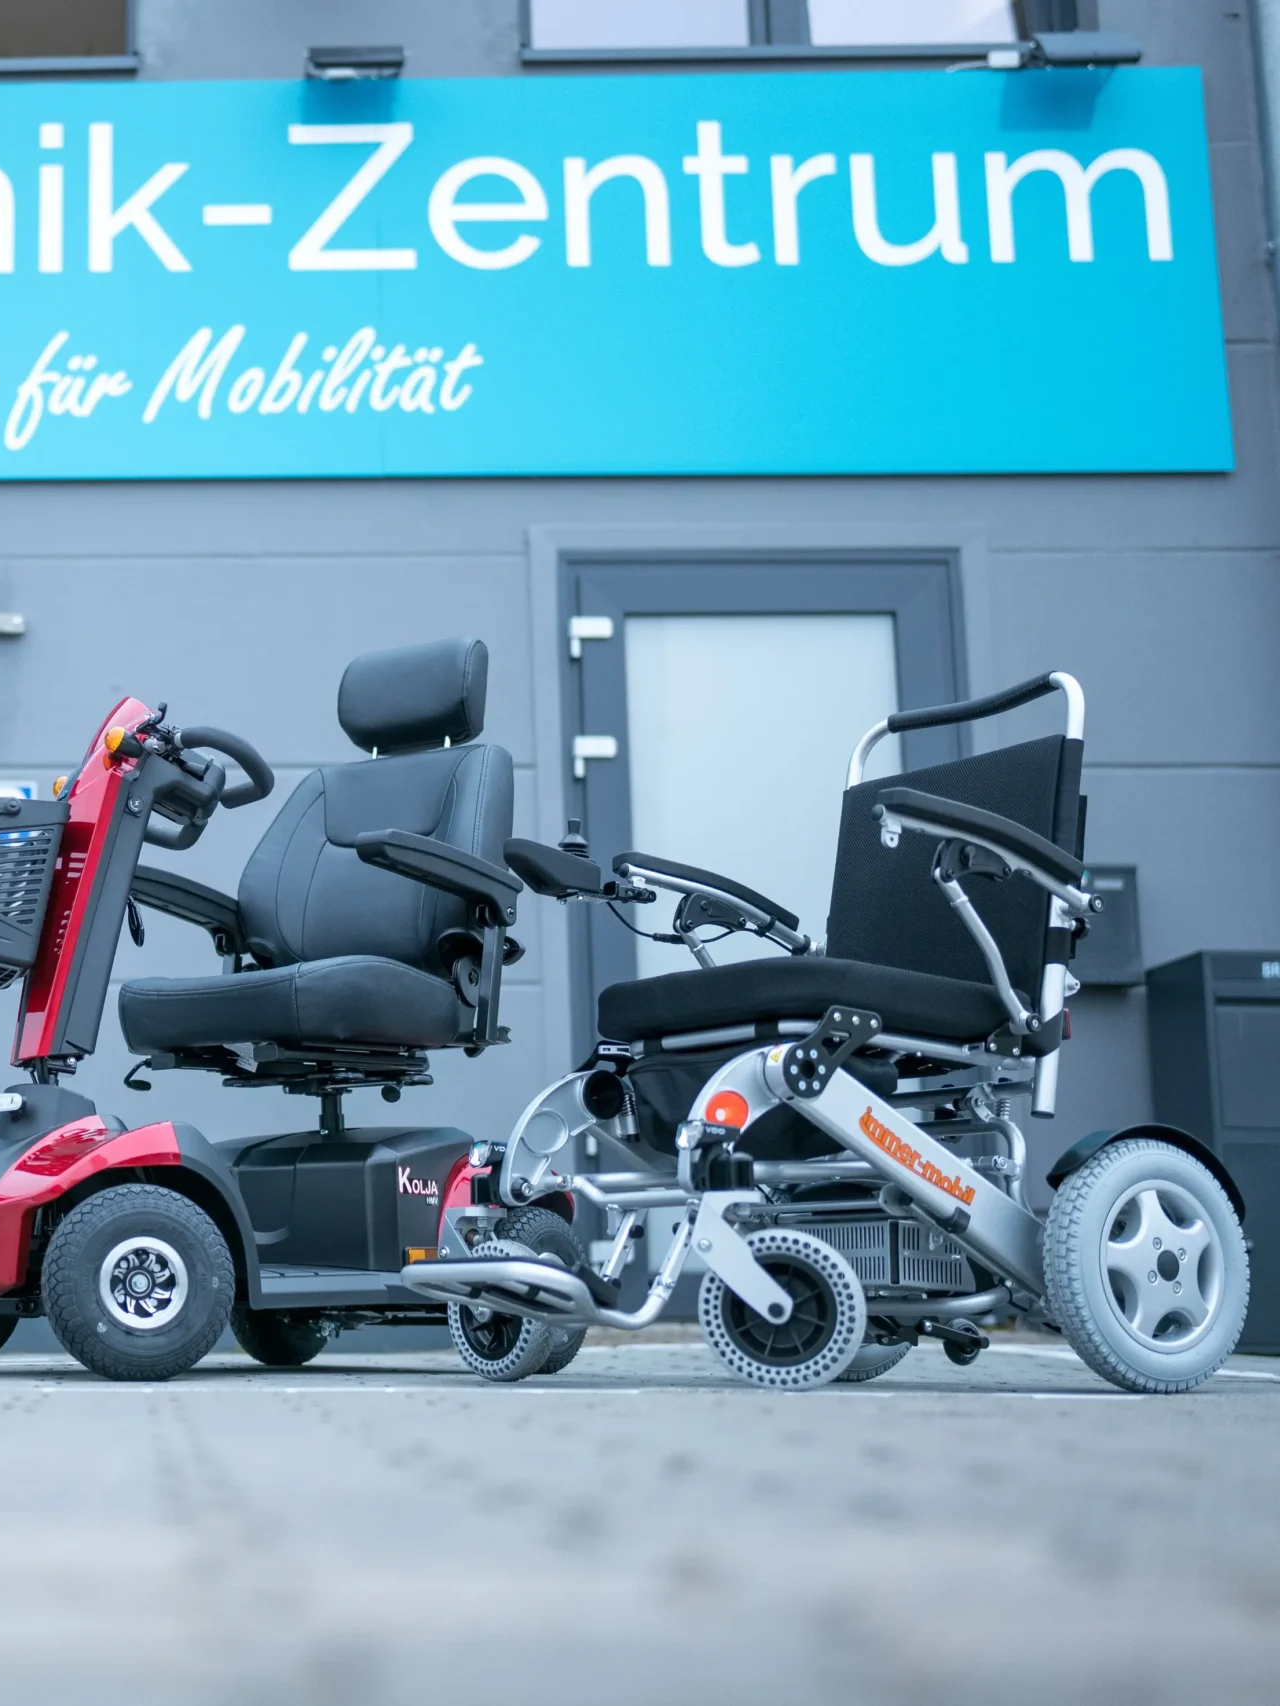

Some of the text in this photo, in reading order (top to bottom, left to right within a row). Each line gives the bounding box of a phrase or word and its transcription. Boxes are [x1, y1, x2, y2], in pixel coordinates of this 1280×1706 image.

[3, 329, 133, 452] für
[141, 323, 486, 425] Mobilität
[398, 1166, 439, 1195] KOLJA
[858, 1106, 976, 1206] immer-mobil
